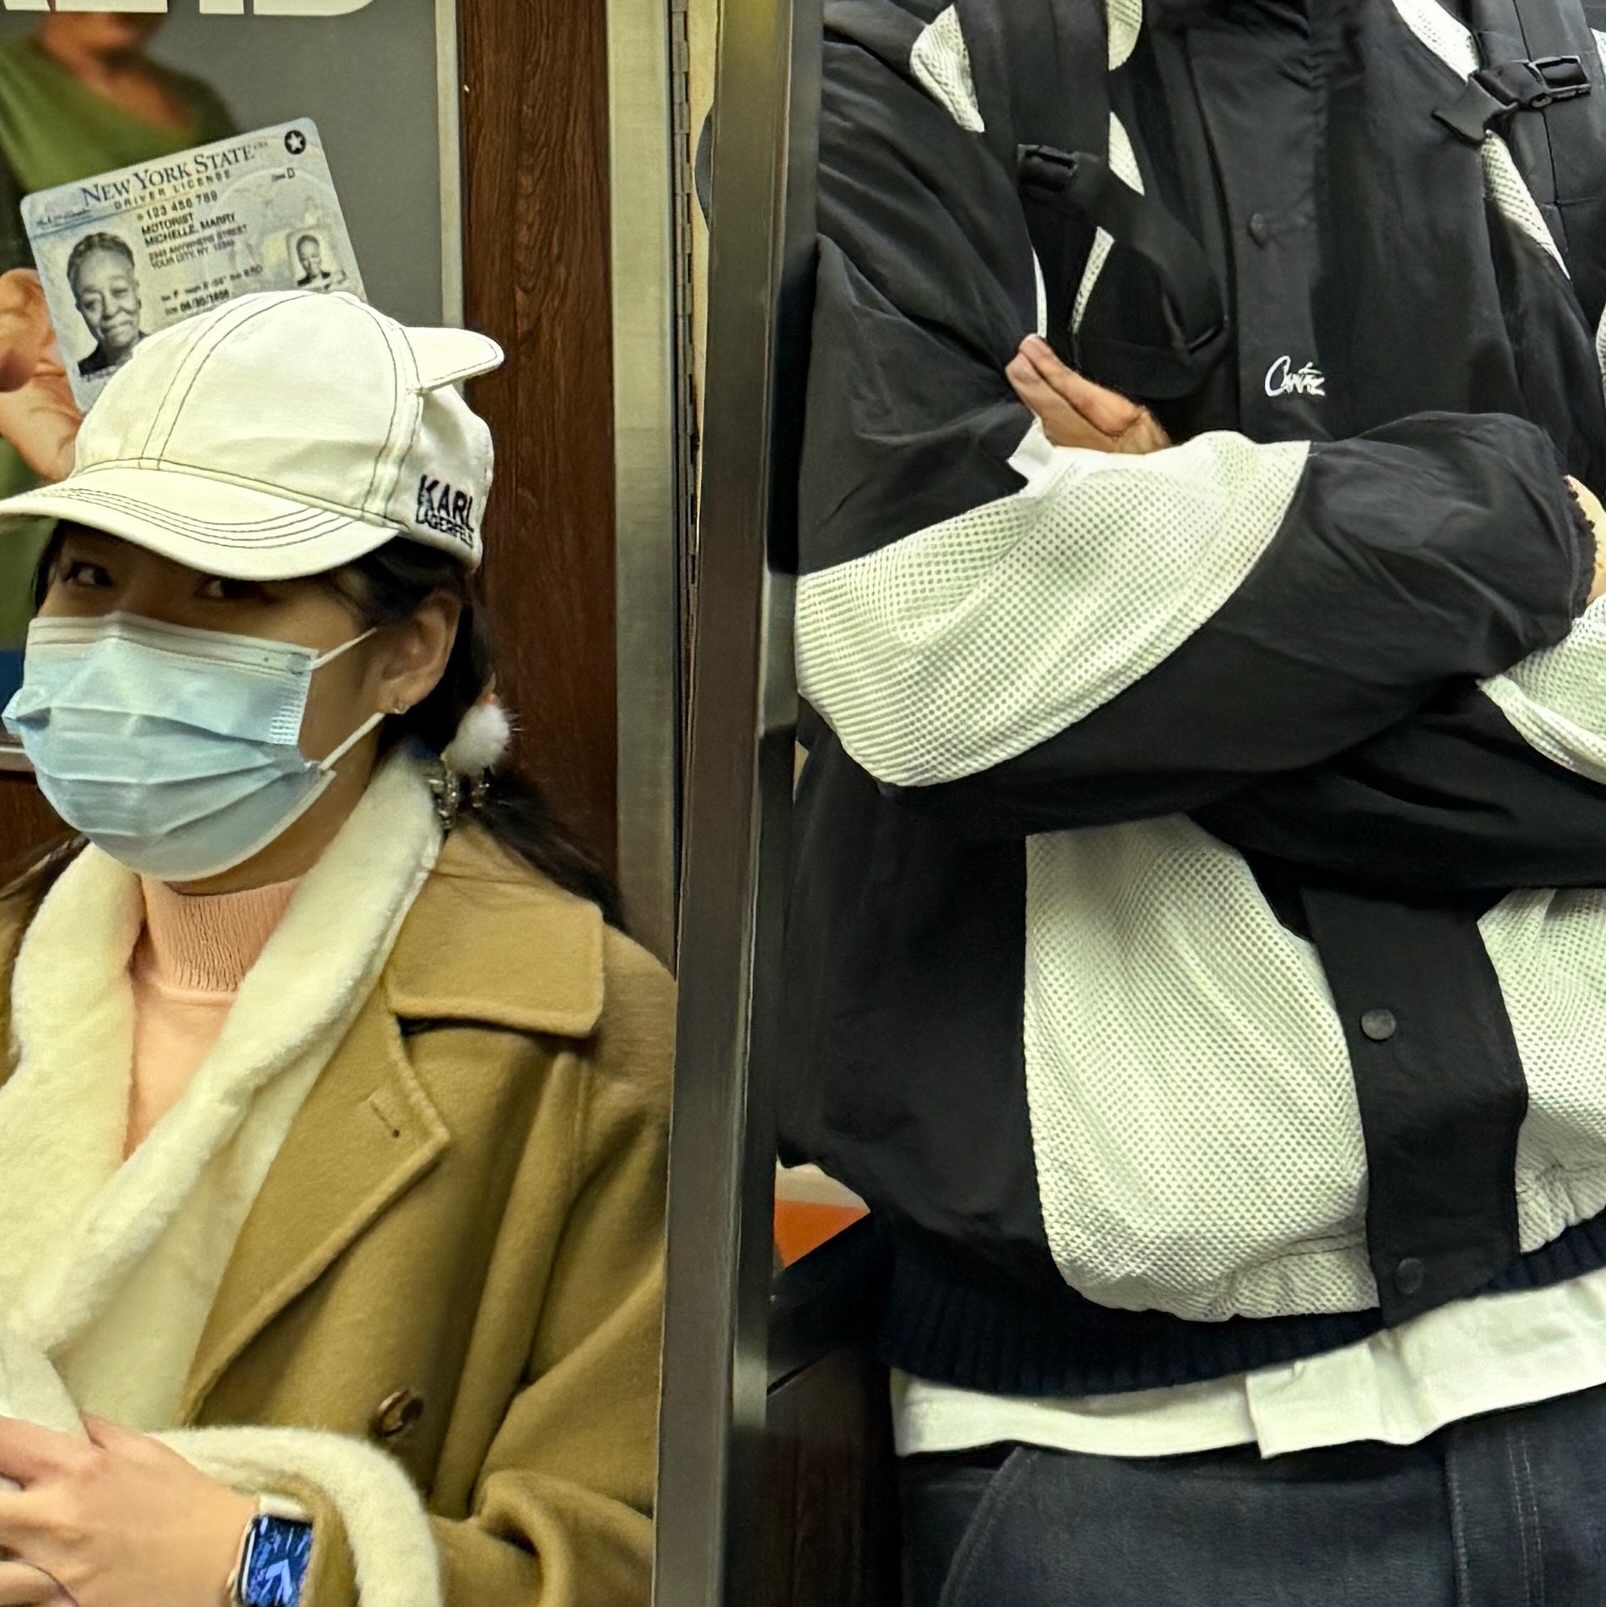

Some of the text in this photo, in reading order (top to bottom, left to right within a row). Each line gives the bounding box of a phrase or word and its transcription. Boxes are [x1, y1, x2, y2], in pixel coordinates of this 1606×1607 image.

[81, 180, 130, 208] NEW
[133, 162, 192, 190] YORK
[194, 145, 256, 174] STATE
[114, 187, 167, 211] DRIVER
[416, 474, 474, 533] KARL
